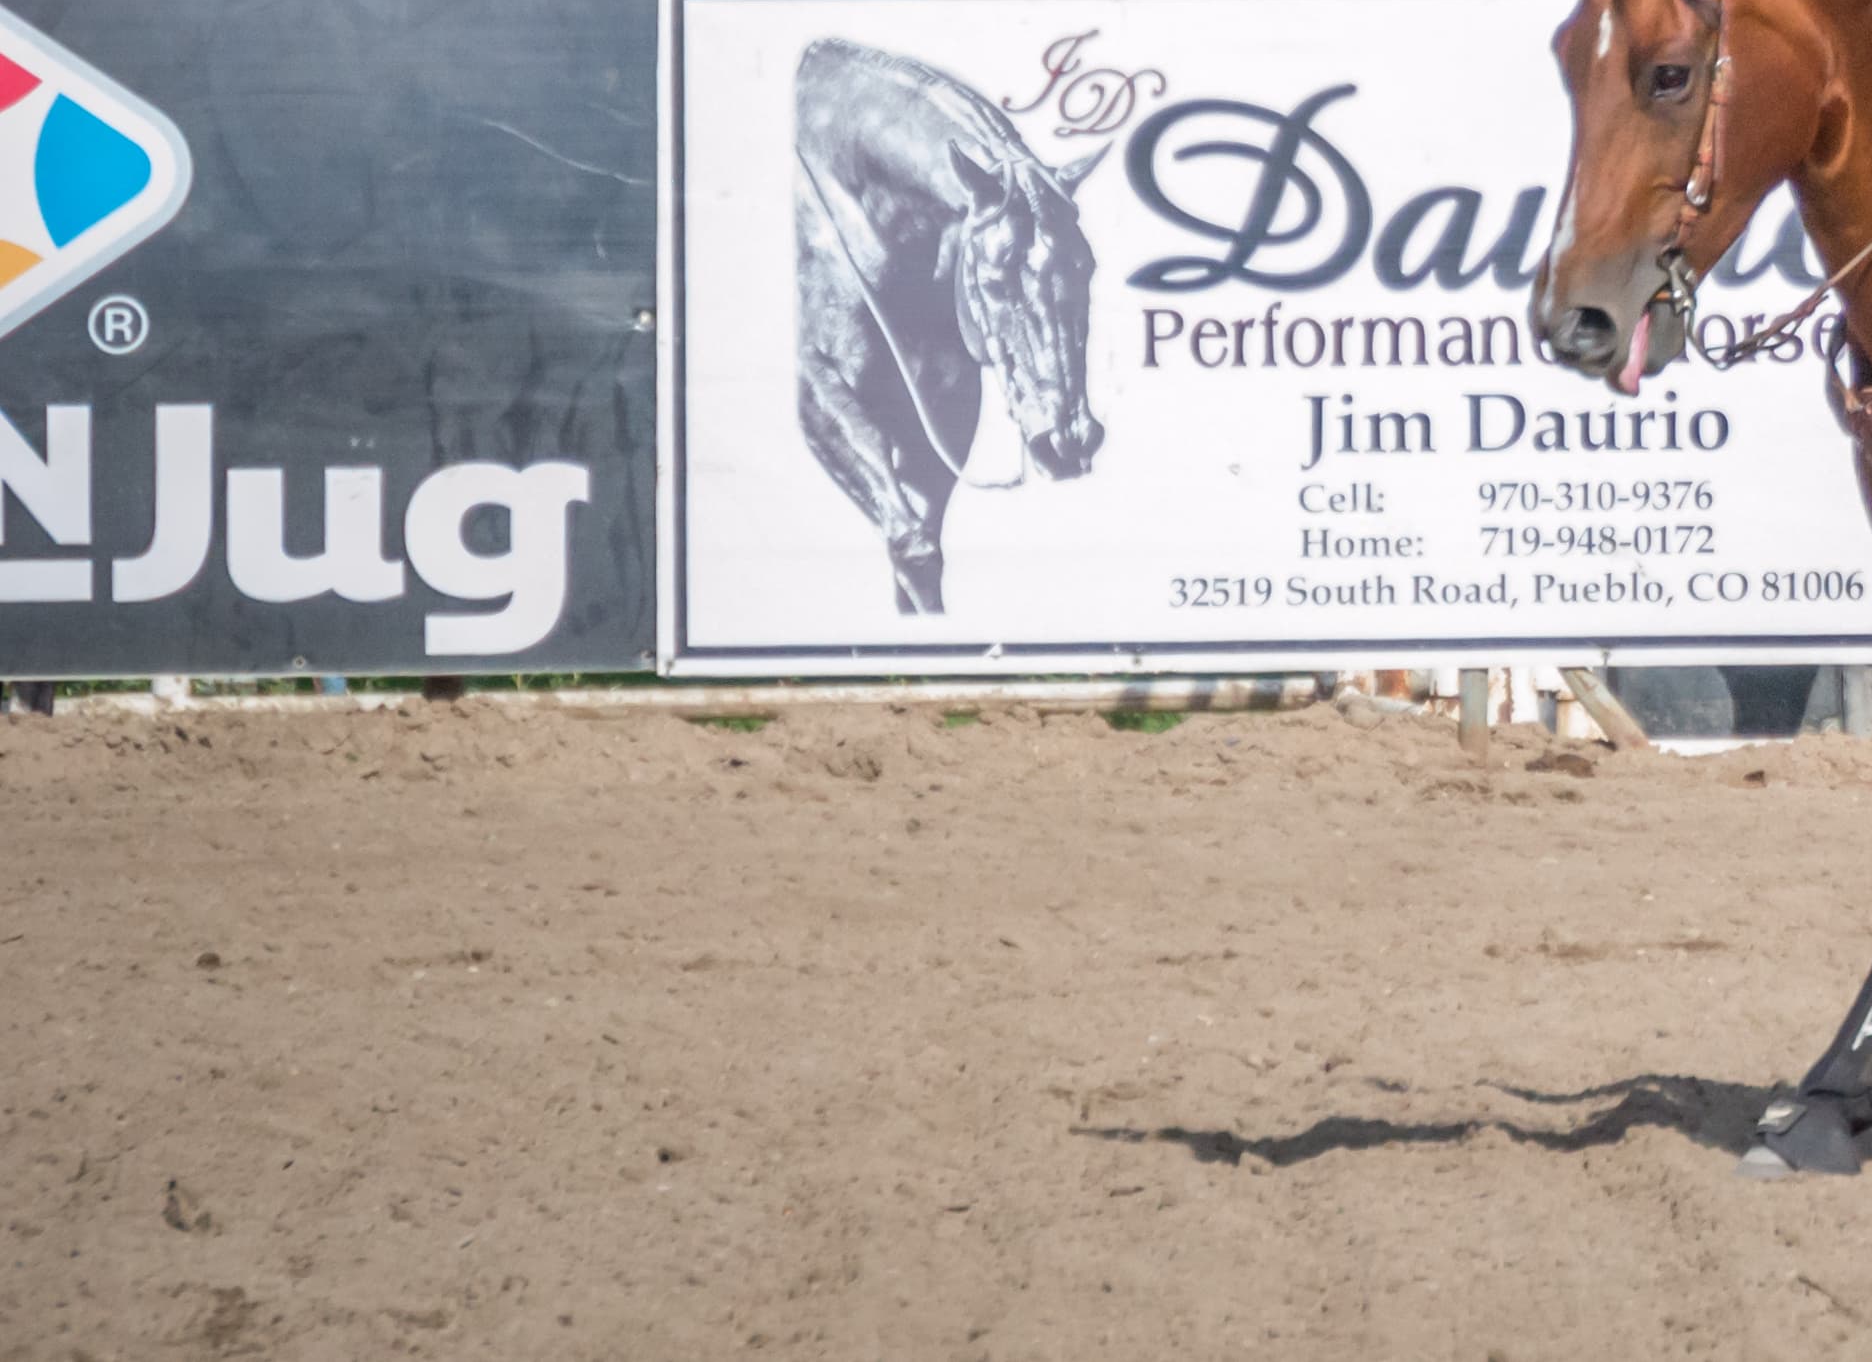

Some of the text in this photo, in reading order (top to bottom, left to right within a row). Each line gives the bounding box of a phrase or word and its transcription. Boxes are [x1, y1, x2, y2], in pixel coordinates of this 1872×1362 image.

[1141, 301, 1556, 369] Performan
[1301, 391, 1730, 471] Jim Daurio
[1298, 480, 1714, 514] Cell: 970-310-9376
[112, 403, 590, 656] Jug
[1301, 524, 1716, 558] Home: 719-948-0172
[1171, 569, 1866, 609] 32519 South Road, Pueblo, CO 81006
